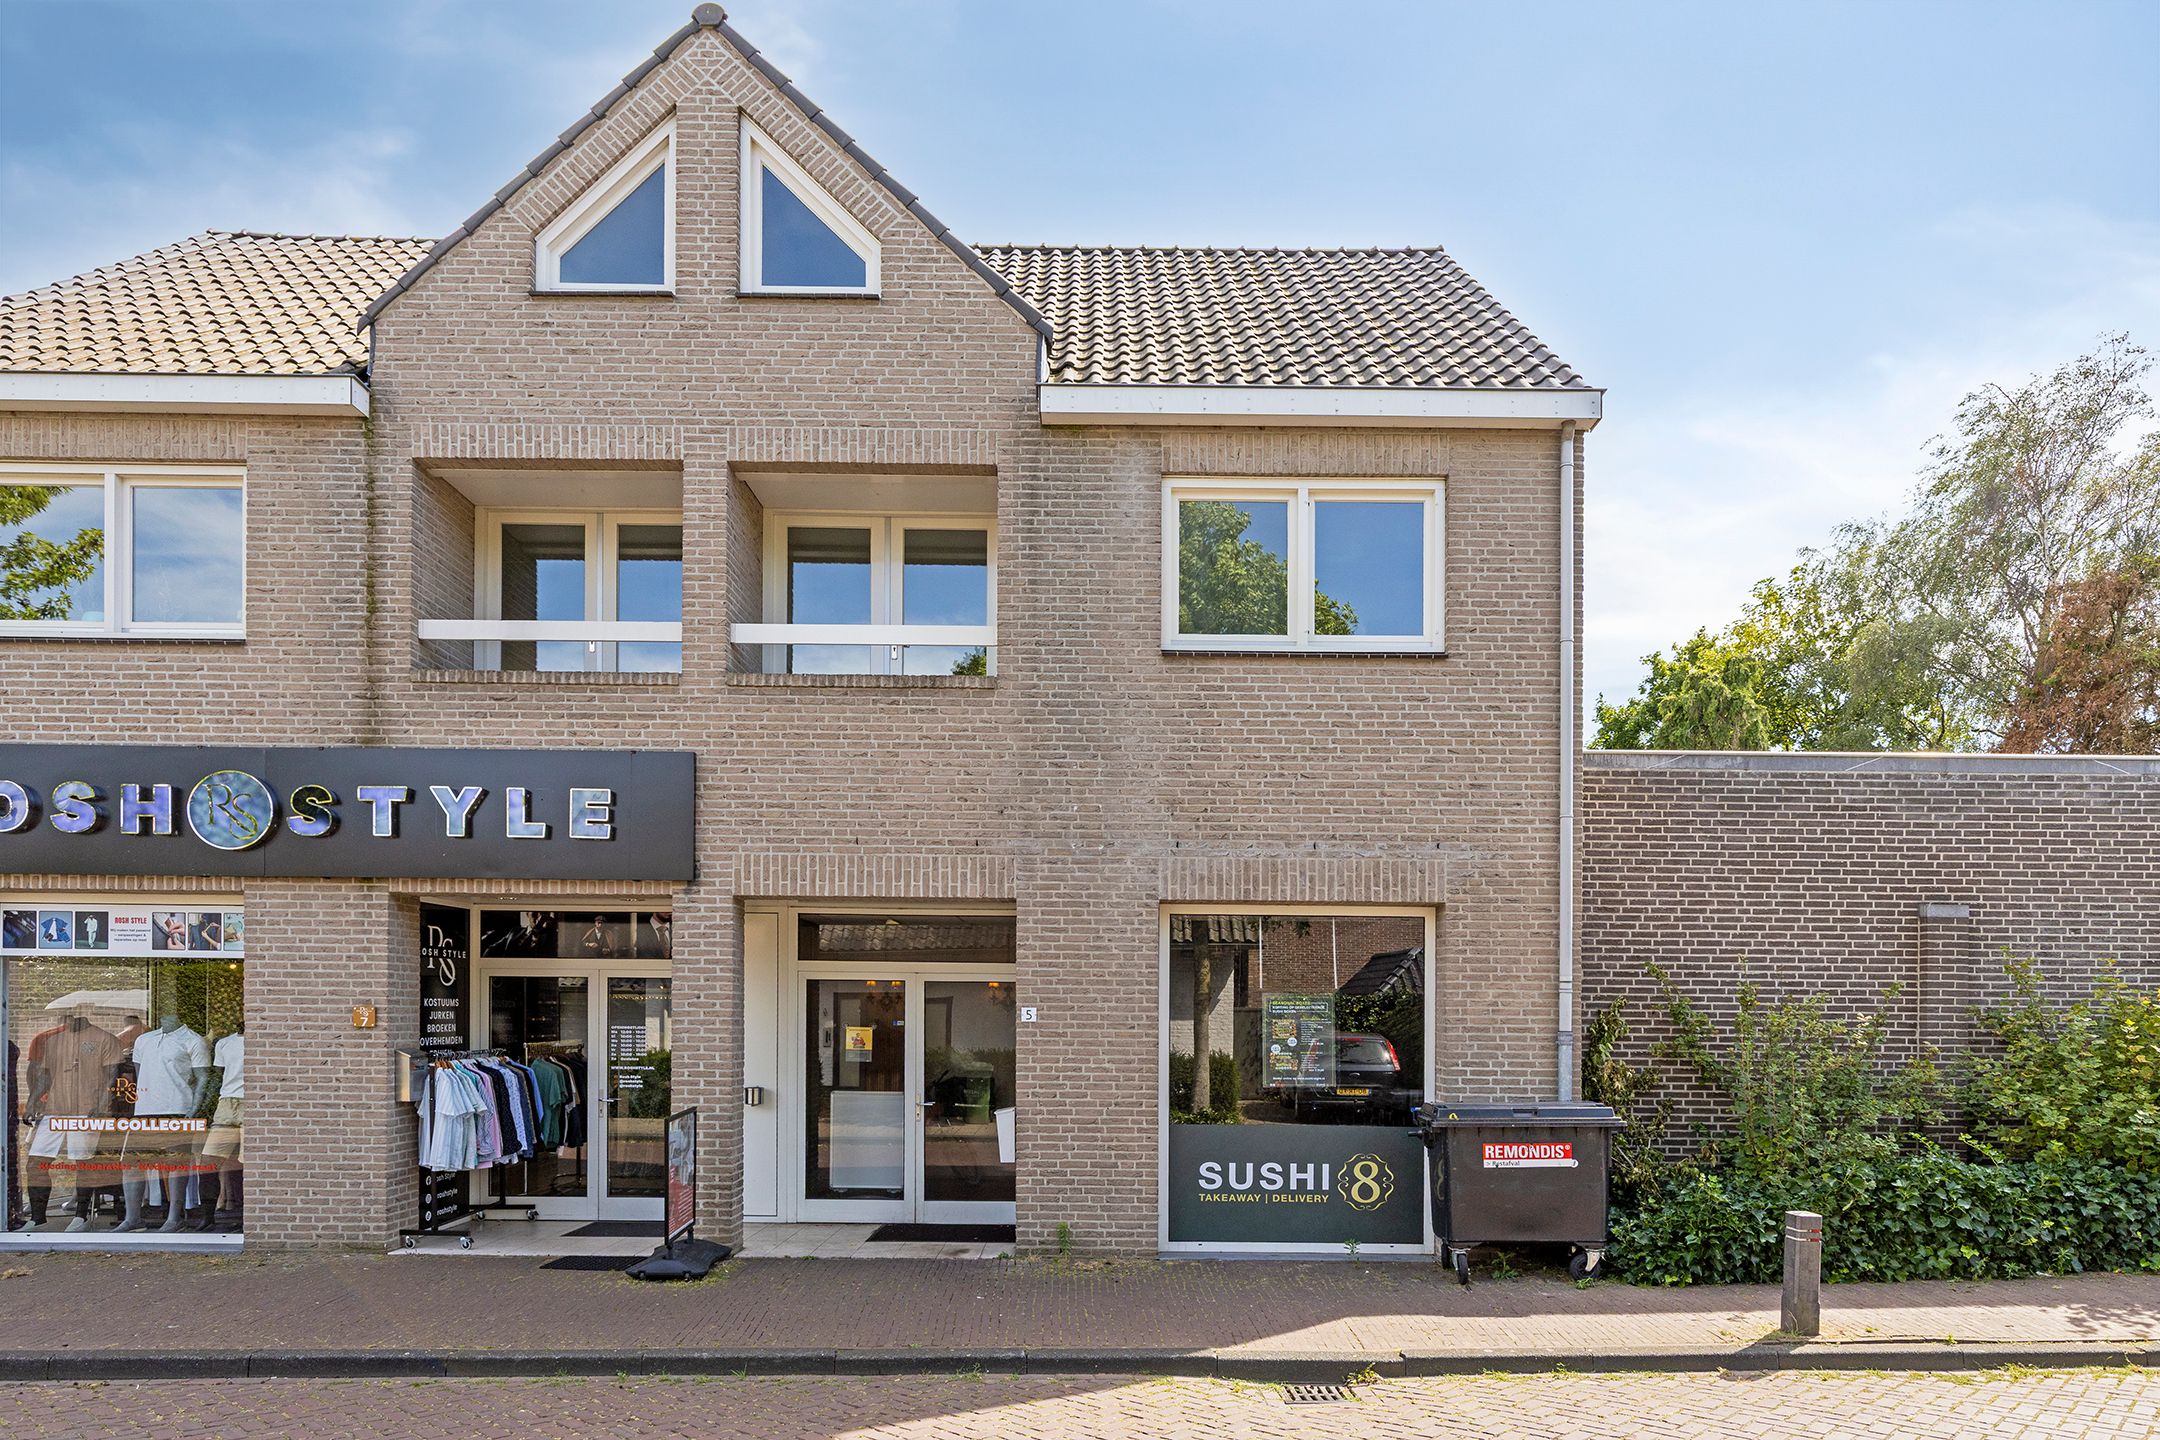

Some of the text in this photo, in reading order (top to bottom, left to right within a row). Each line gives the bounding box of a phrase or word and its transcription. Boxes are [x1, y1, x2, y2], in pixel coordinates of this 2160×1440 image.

[286, 784, 611, 839] STYLE
[422, 947, 467, 959] OSH STYLE
[423, 997, 460, 1007] KOSTUUMS
[429, 1010, 455, 1020] JURKEN
[1025, 1009, 1033, 1020] 5
[360, 1016, 369, 1027] 7
[426, 1023, 457, 1033] BROEKEN
[419, 1035, 463, 1047] OVERHEMDEN
[50, 1118, 206, 1132] NIEUWE COLLECTIE
[1485, 1144, 1565, 1159] REMONDIS
[1198, 1160, 1381, 1204] SUSHI 8
[1198, 1193, 1329, 1204] TAKEAWAY DELIVERY
